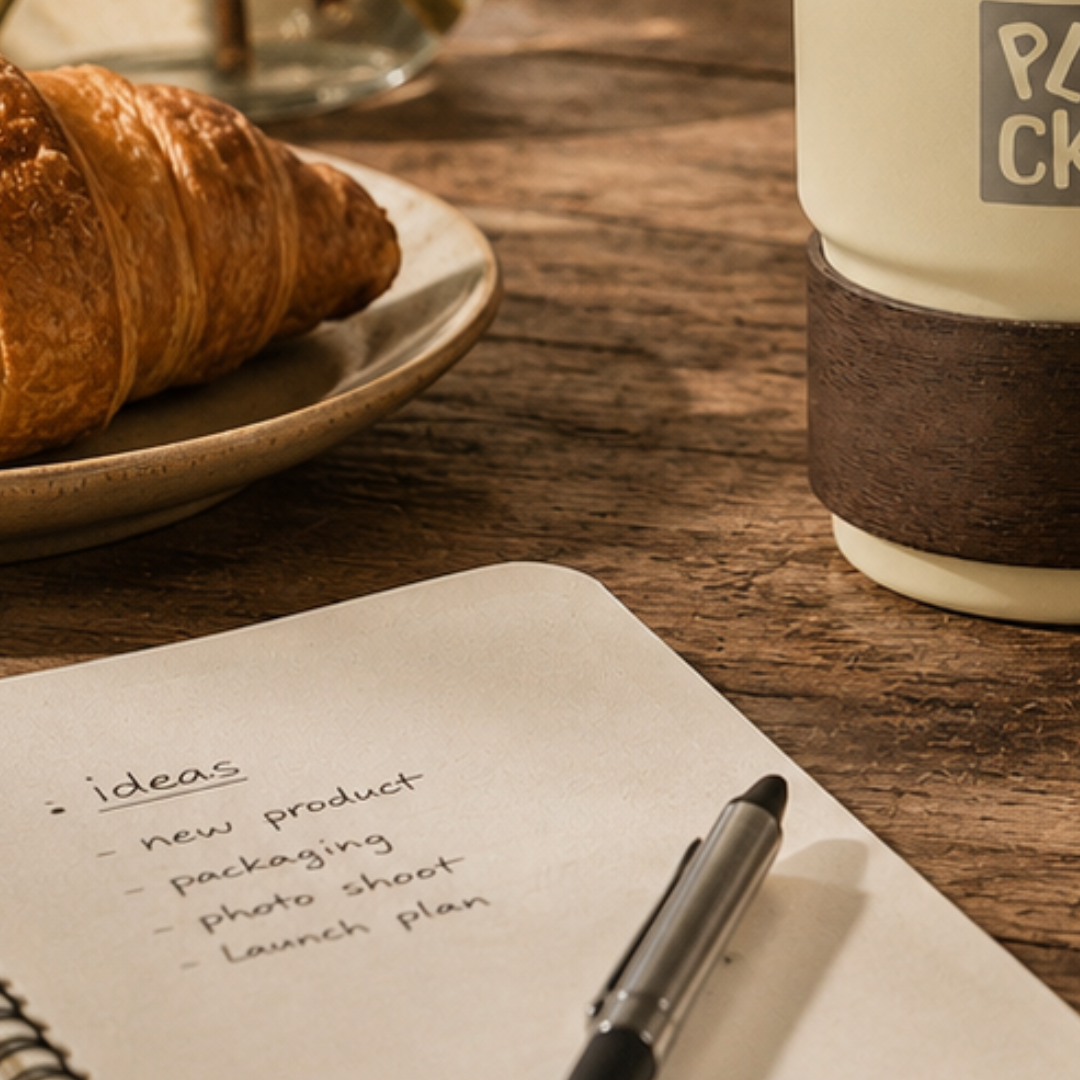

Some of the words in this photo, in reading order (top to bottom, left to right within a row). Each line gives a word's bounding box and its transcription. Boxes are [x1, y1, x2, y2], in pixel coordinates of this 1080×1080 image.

[86, 760, 241, 803] ideas
[140, 821, 233, 852] new
[263, 772, 424, 832] product
[169, 832, 394, 898] packaging
[198, 893, 315, 935] photo
[341, 856, 465, 897] shoot
[396, 894, 491, 932] plan
